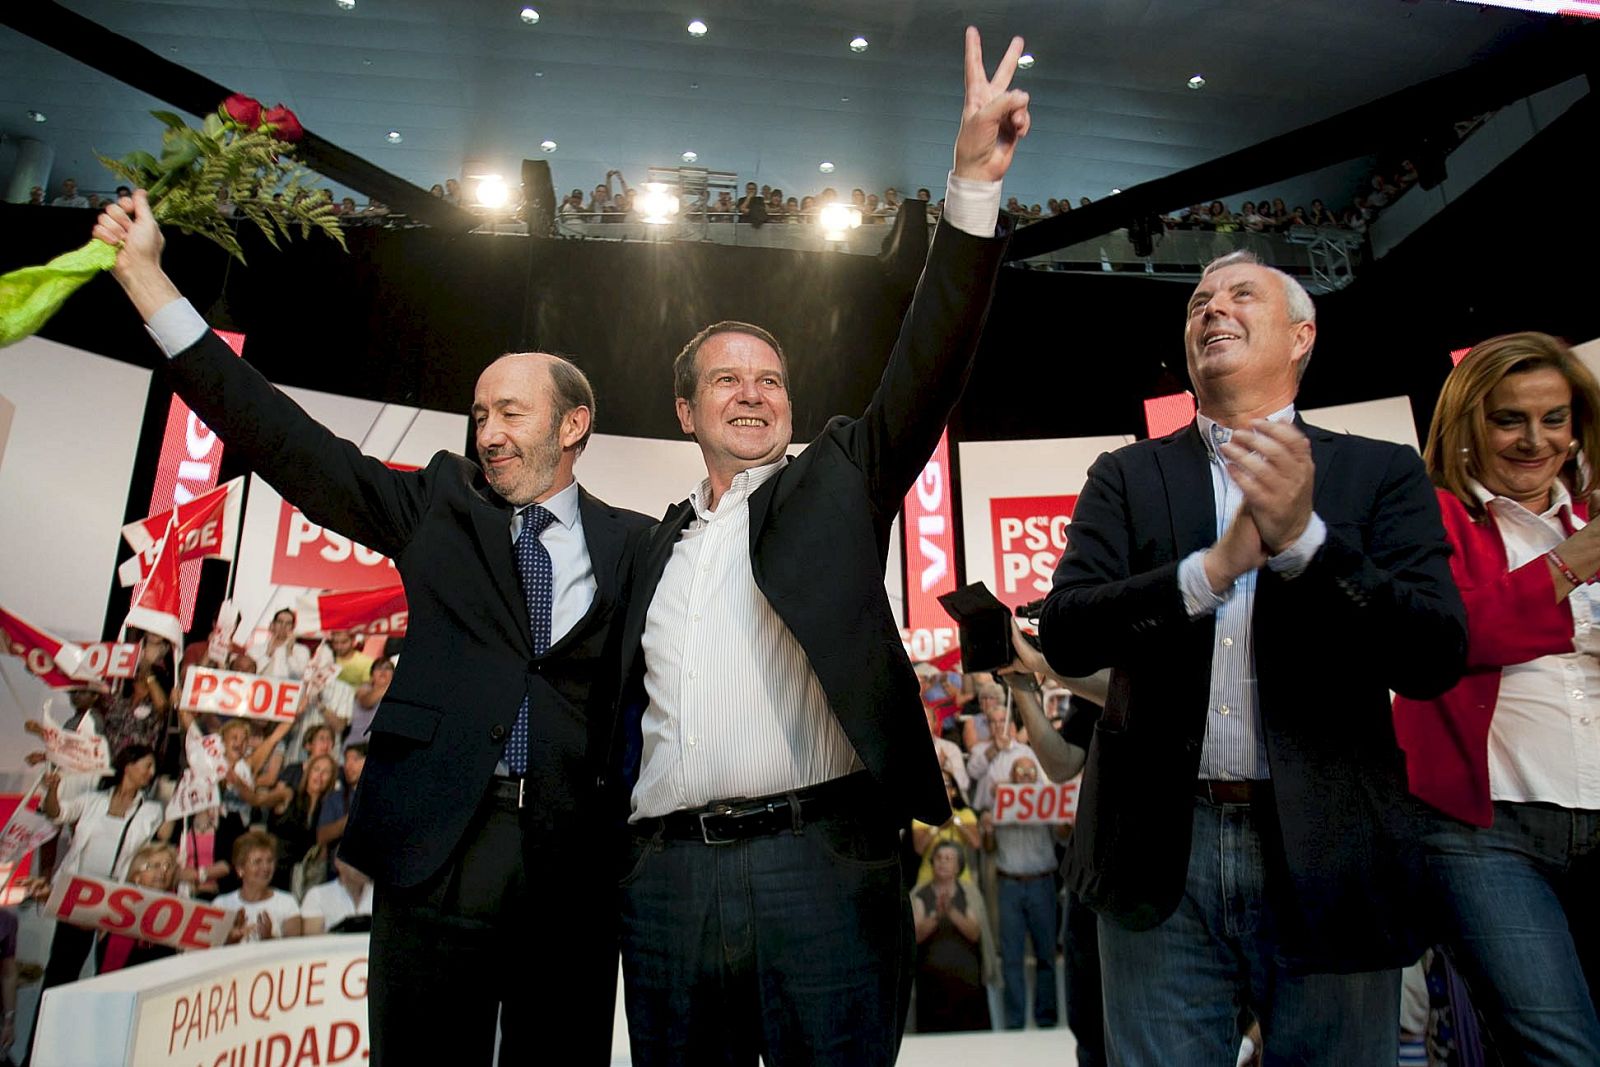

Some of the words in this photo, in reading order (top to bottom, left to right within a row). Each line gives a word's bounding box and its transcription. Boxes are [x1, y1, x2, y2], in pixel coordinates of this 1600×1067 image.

[189, 672, 300, 719] PSOE
[996, 784, 1076, 820] PSOE
[56, 877, 226, 949] PSOE
[168, 977, 238, 1057] PARA
[249, 961, 327, 1022] QUE
